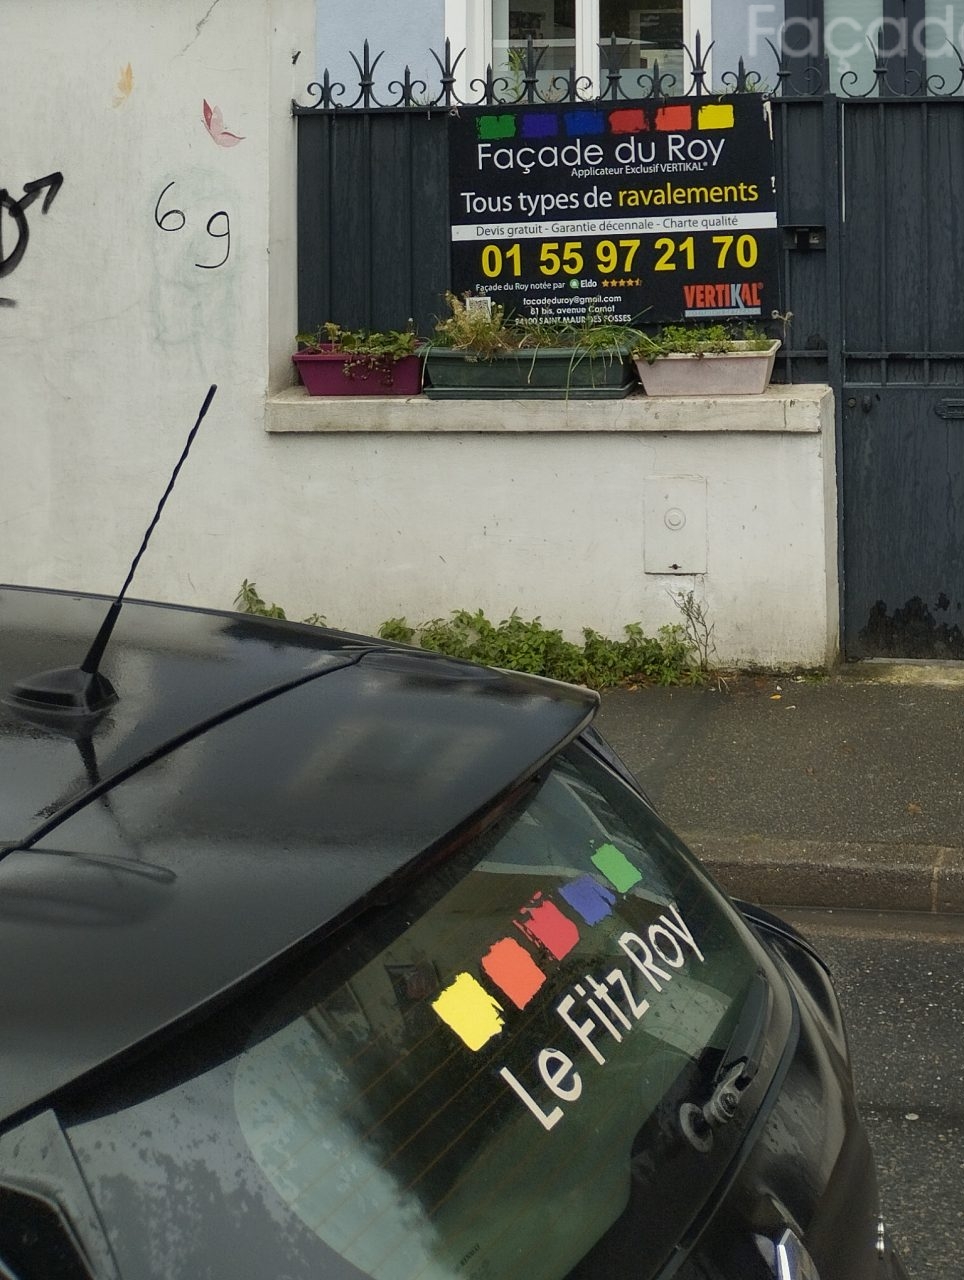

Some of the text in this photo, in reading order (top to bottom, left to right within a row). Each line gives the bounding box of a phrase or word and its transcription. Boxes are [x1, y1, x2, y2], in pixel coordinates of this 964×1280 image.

[477, 134, 726, 175] Façade du Roy
[571, 166, 624, 178] Applicateur
[625, 163, 661, 174] Exclusif
[460, 182, 759, 217] Tous types de ravalements
[476, 226, 505, 237] Devis
[507, 224, 543, 238] gratuit
[551, 222, 597, 234] Garantie
[599, 219, 654, 232] décennale
[663, 217, 699, 229] Charte
[701, 215, 738, 230] qualité
[481, 234, 758, 278] 01 55 97 21 70
[475, 279, 598, 293] Façade du Roy notée par Eldo
[556, 307, 587, 315] avenue
[499, 903, 705, 1131] Le Fitz Roy
